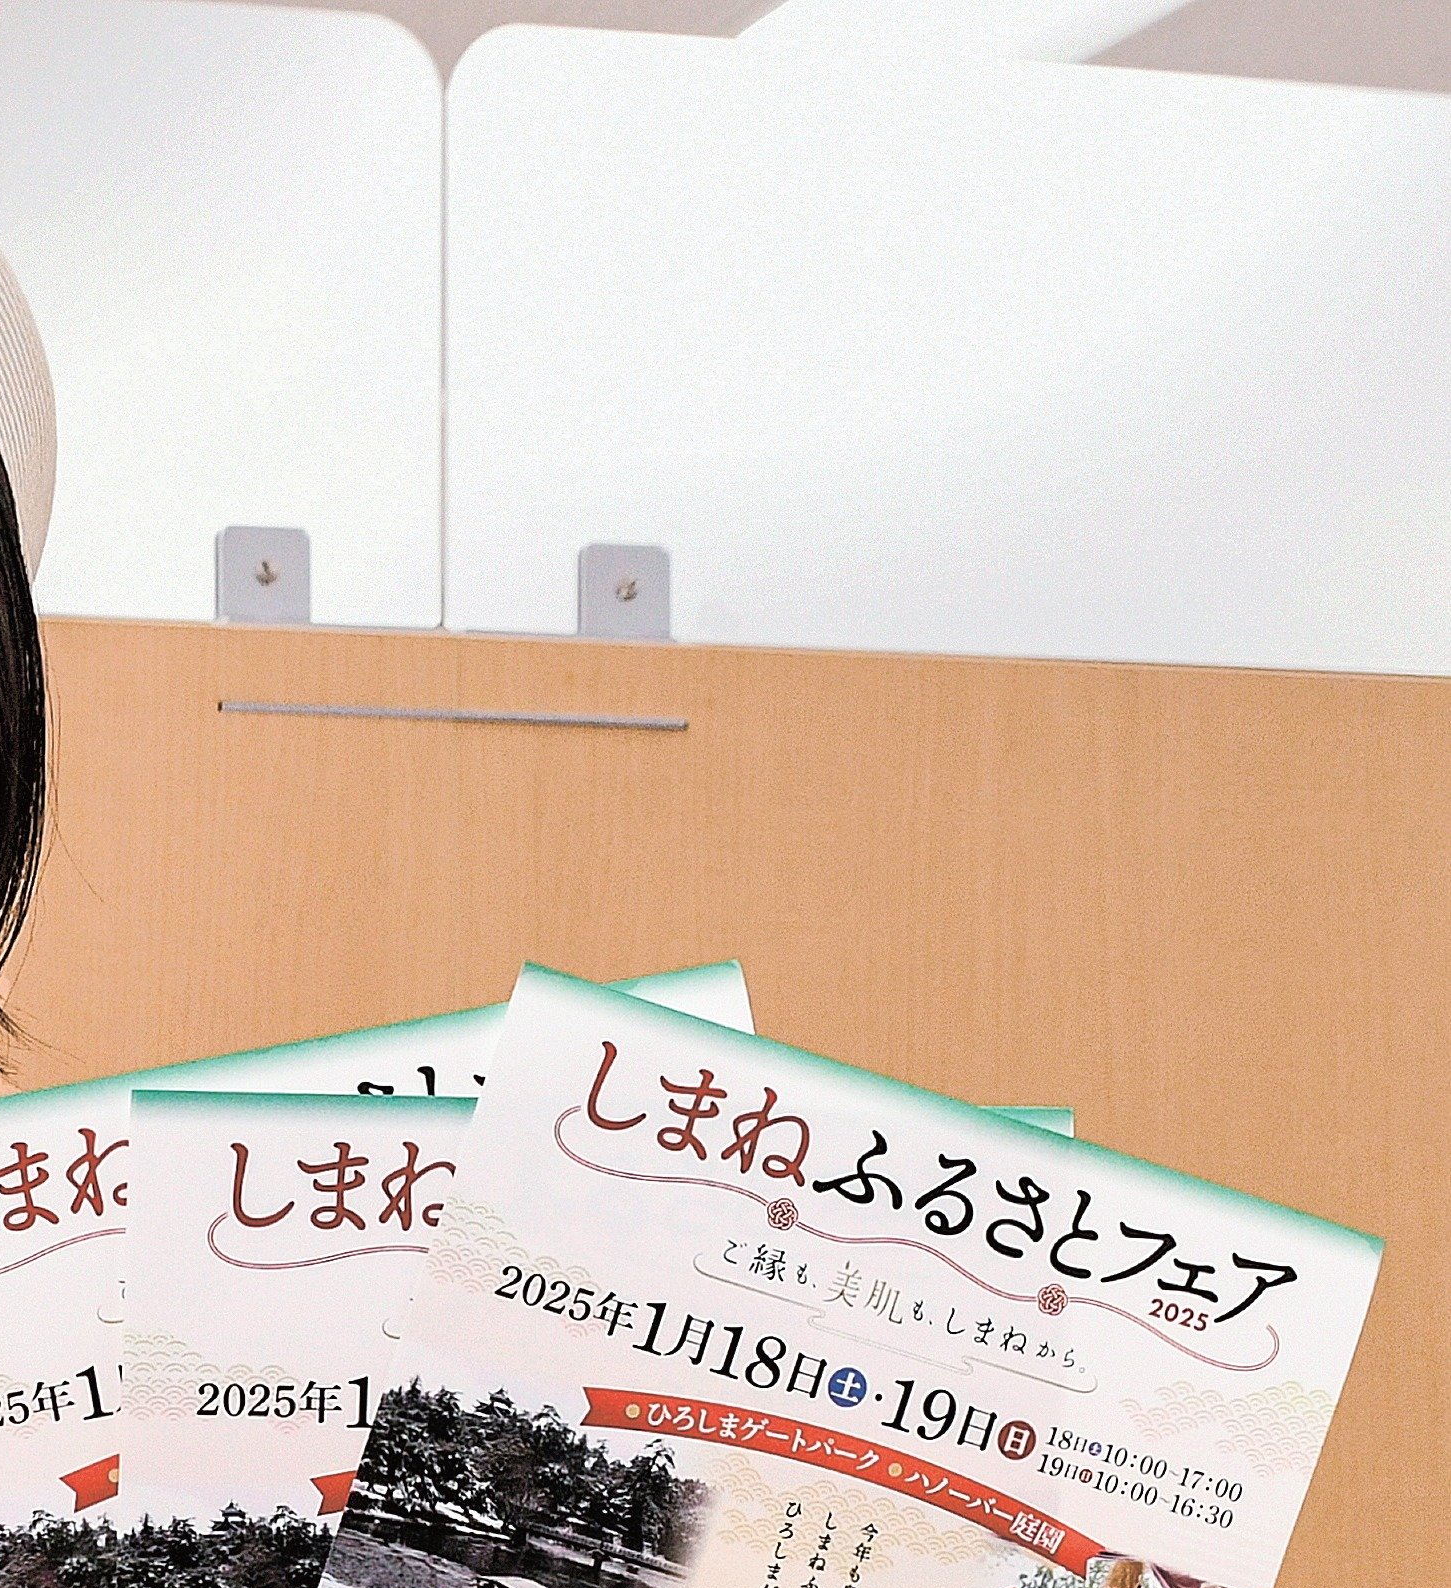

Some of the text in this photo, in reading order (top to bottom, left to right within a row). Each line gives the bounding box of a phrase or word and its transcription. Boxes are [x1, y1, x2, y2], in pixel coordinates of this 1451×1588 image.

[583, 1040, 1297, 1327] しまねふるさとフェア
[1148, 1297, 1209, 1333] 2025
[646, 1402, 1066, 1556] ひろしまゲートパーク ハノーバー庭園
